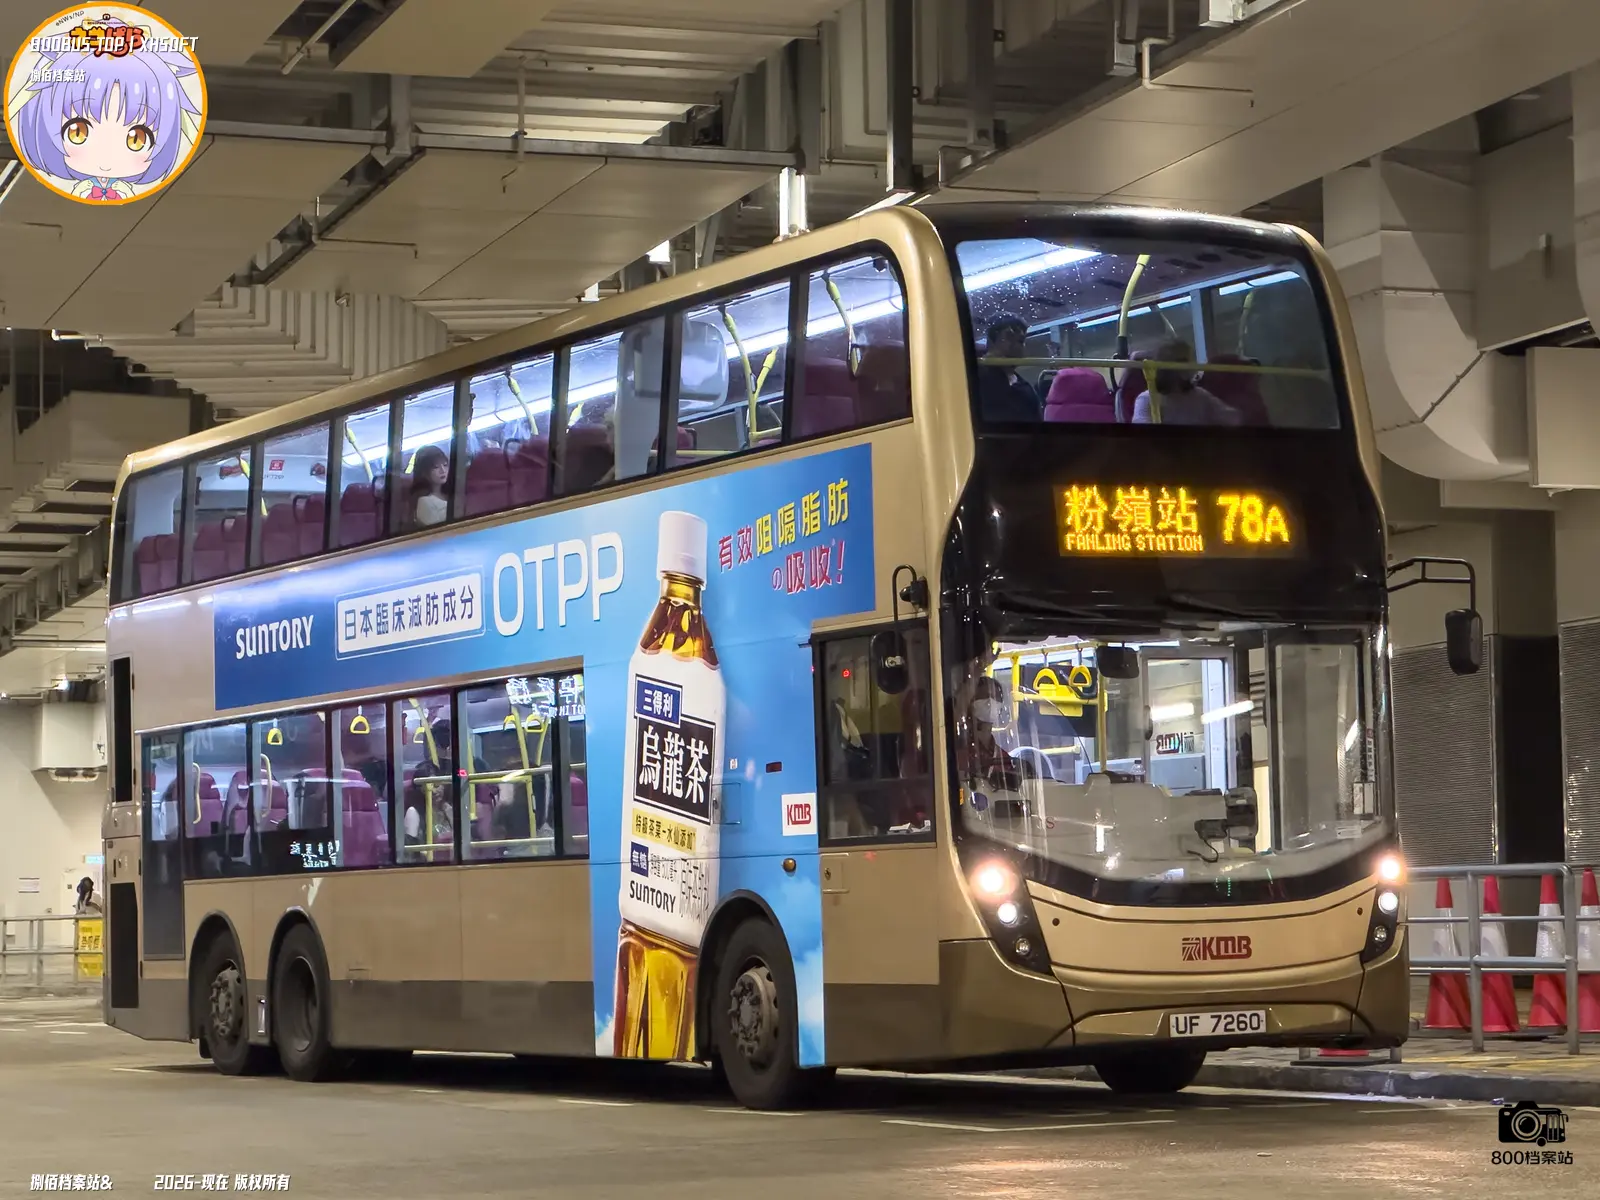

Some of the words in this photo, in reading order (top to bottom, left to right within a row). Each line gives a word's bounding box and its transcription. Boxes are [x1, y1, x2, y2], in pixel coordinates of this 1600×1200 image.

[718, 478, 849, 573] 有效阻隔脂肪
[1065, 485, 1198, 533] 粉嶺站
[1217, 495, 1290, 542] 78A
[1065, 533, 1131, 551] FANLING
[1136, 534, 1204, 552] STATION
[492, 531, 625, 637] OTPP
[344, 584, 475, 641] 日本臨床減肪成分
[235, 615, 314, 660] SUNTORY
[643, 688, 674, 719] 三得利
[638, 725, 710, 804] 烏龍茶
[786, 803, 812, 826] KMB
[629, 880, 677, 914] SUNTORY
[1201, 935, 1253, 961] KMB
[1175, 1015, 1200, 1035] UF
[1210, 1012, 1260, 1033] 7260
